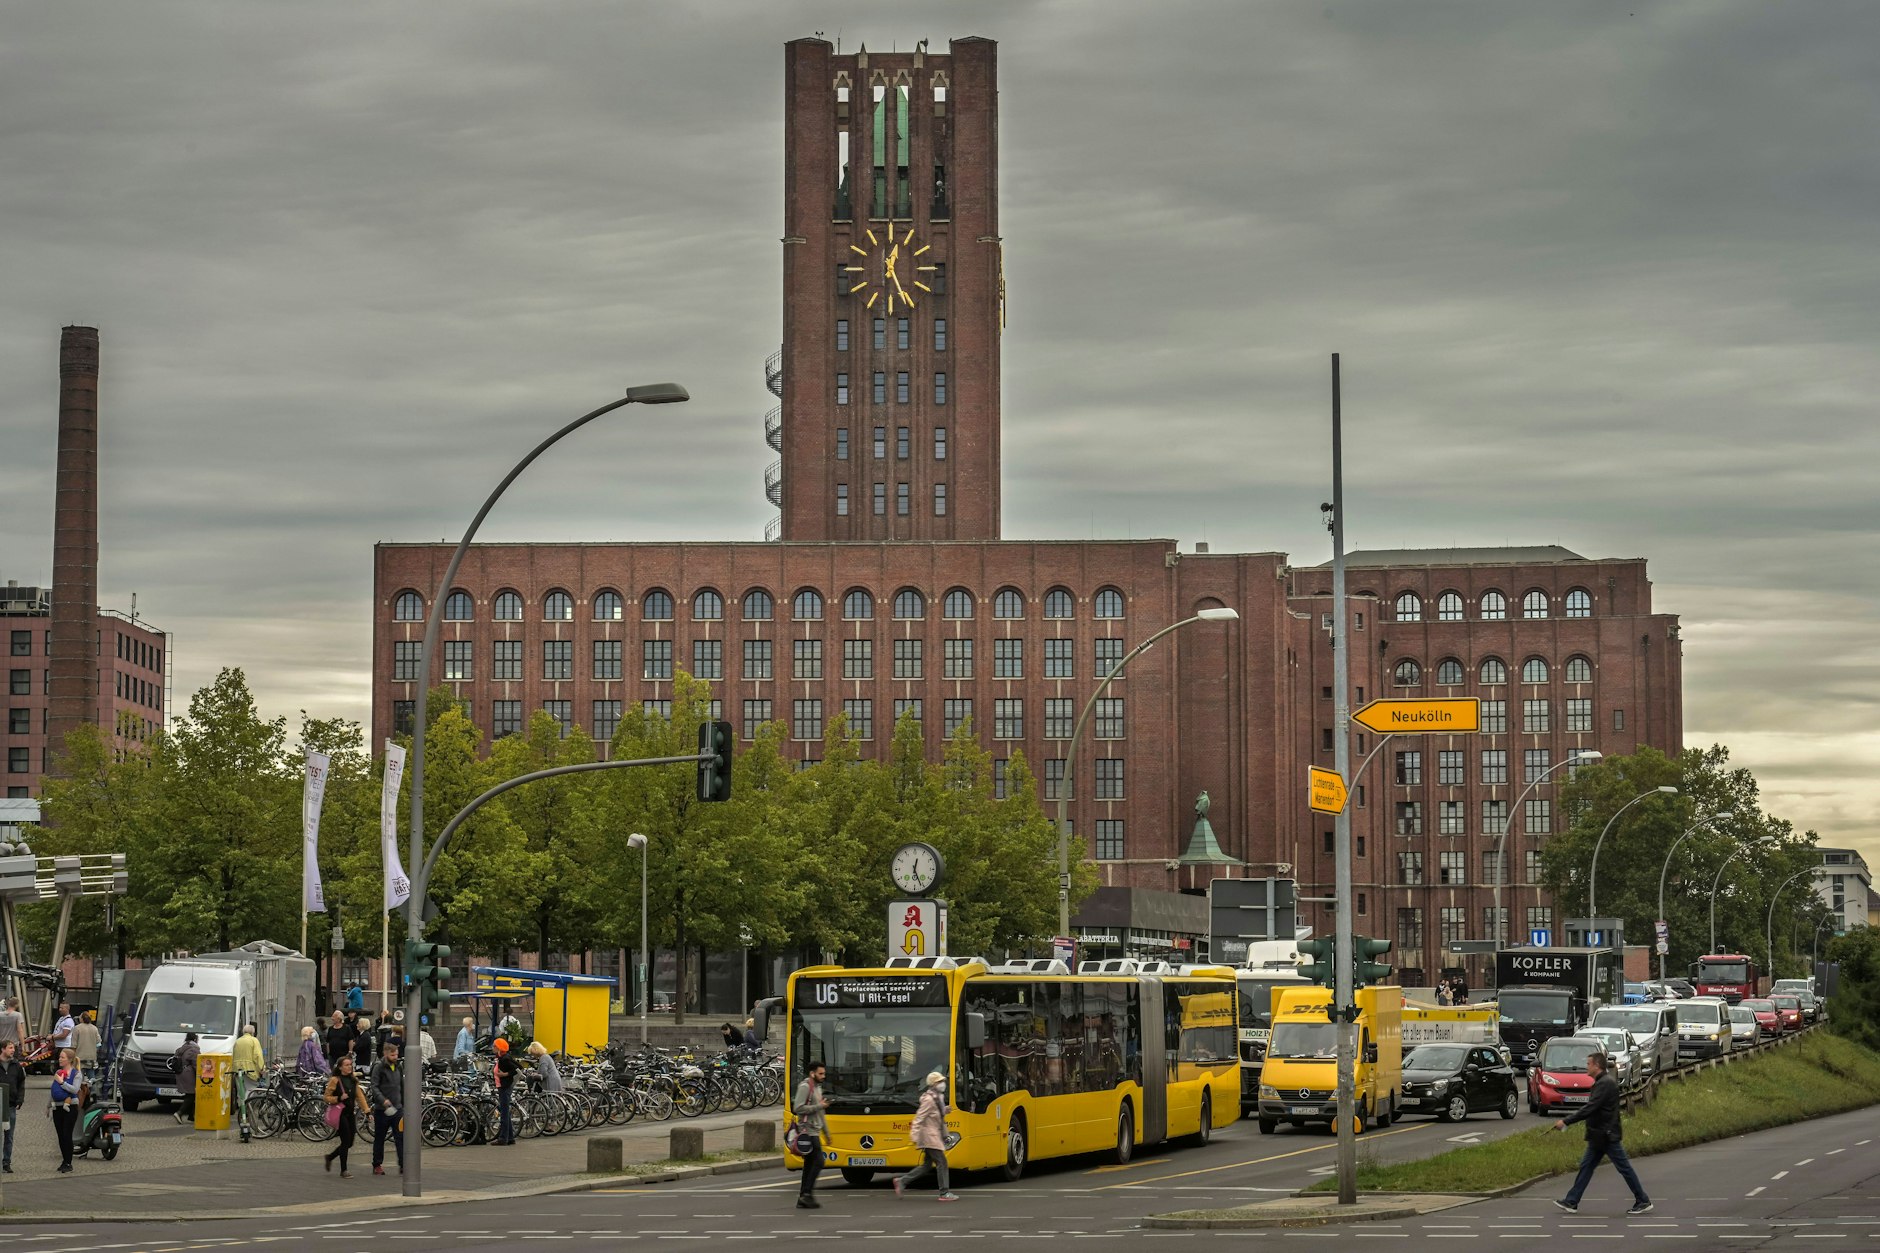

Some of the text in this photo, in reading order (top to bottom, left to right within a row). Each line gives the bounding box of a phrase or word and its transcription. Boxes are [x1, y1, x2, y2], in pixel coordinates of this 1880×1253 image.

[1392, 710, 1452, 722] Neukölln
[1533, 932, 1546, 947] U
[1512, 957, 1572, 970] KOFLER
[816, 984, 839, 1004] U6
[859, 993, 910, 1003] U Alt-Tegel
[1292, 1004, 1328, 1014] DH
[1410, 1023, 1421, 1040] alles
[1424, 1029, 1434, 1040] zum
